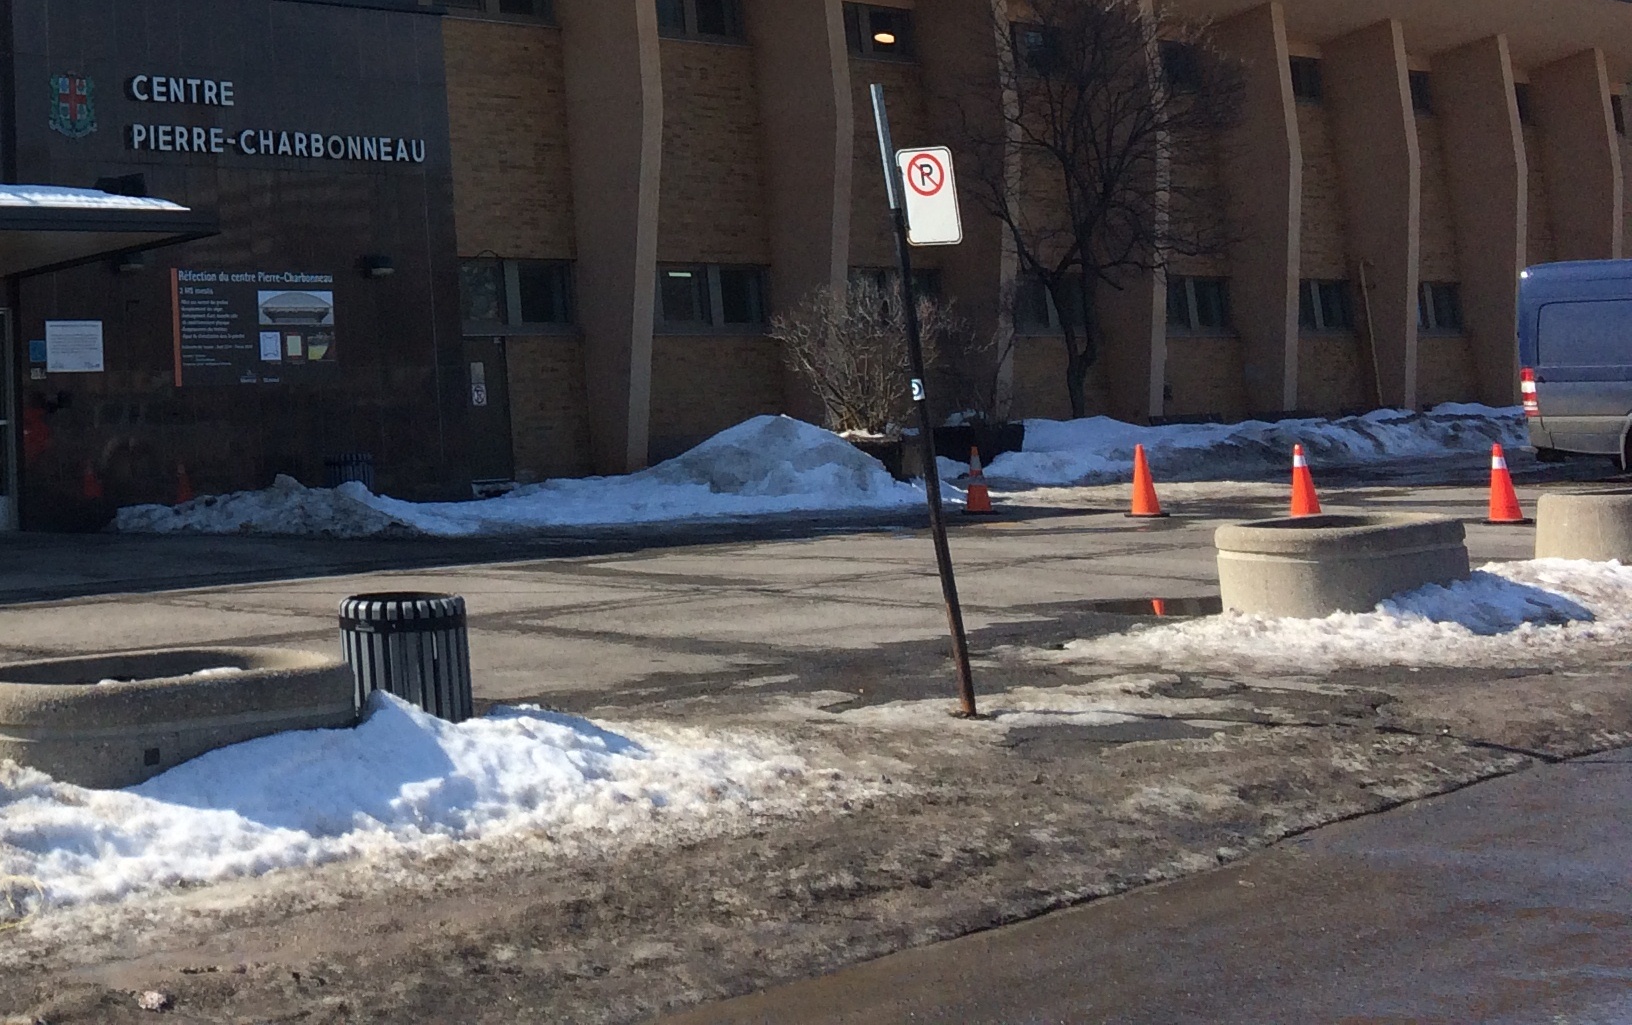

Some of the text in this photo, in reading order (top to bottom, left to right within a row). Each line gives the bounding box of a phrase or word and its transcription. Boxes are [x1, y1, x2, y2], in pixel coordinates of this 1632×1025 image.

[133, 75, 235, 106] CENTRE
[133, 125, 426, 163] PIERRE-CHARBONNEAU
[920, 164, 933, 186] P
[219, 271, 229, 282] du
[231, 272, 256, 282] centre
